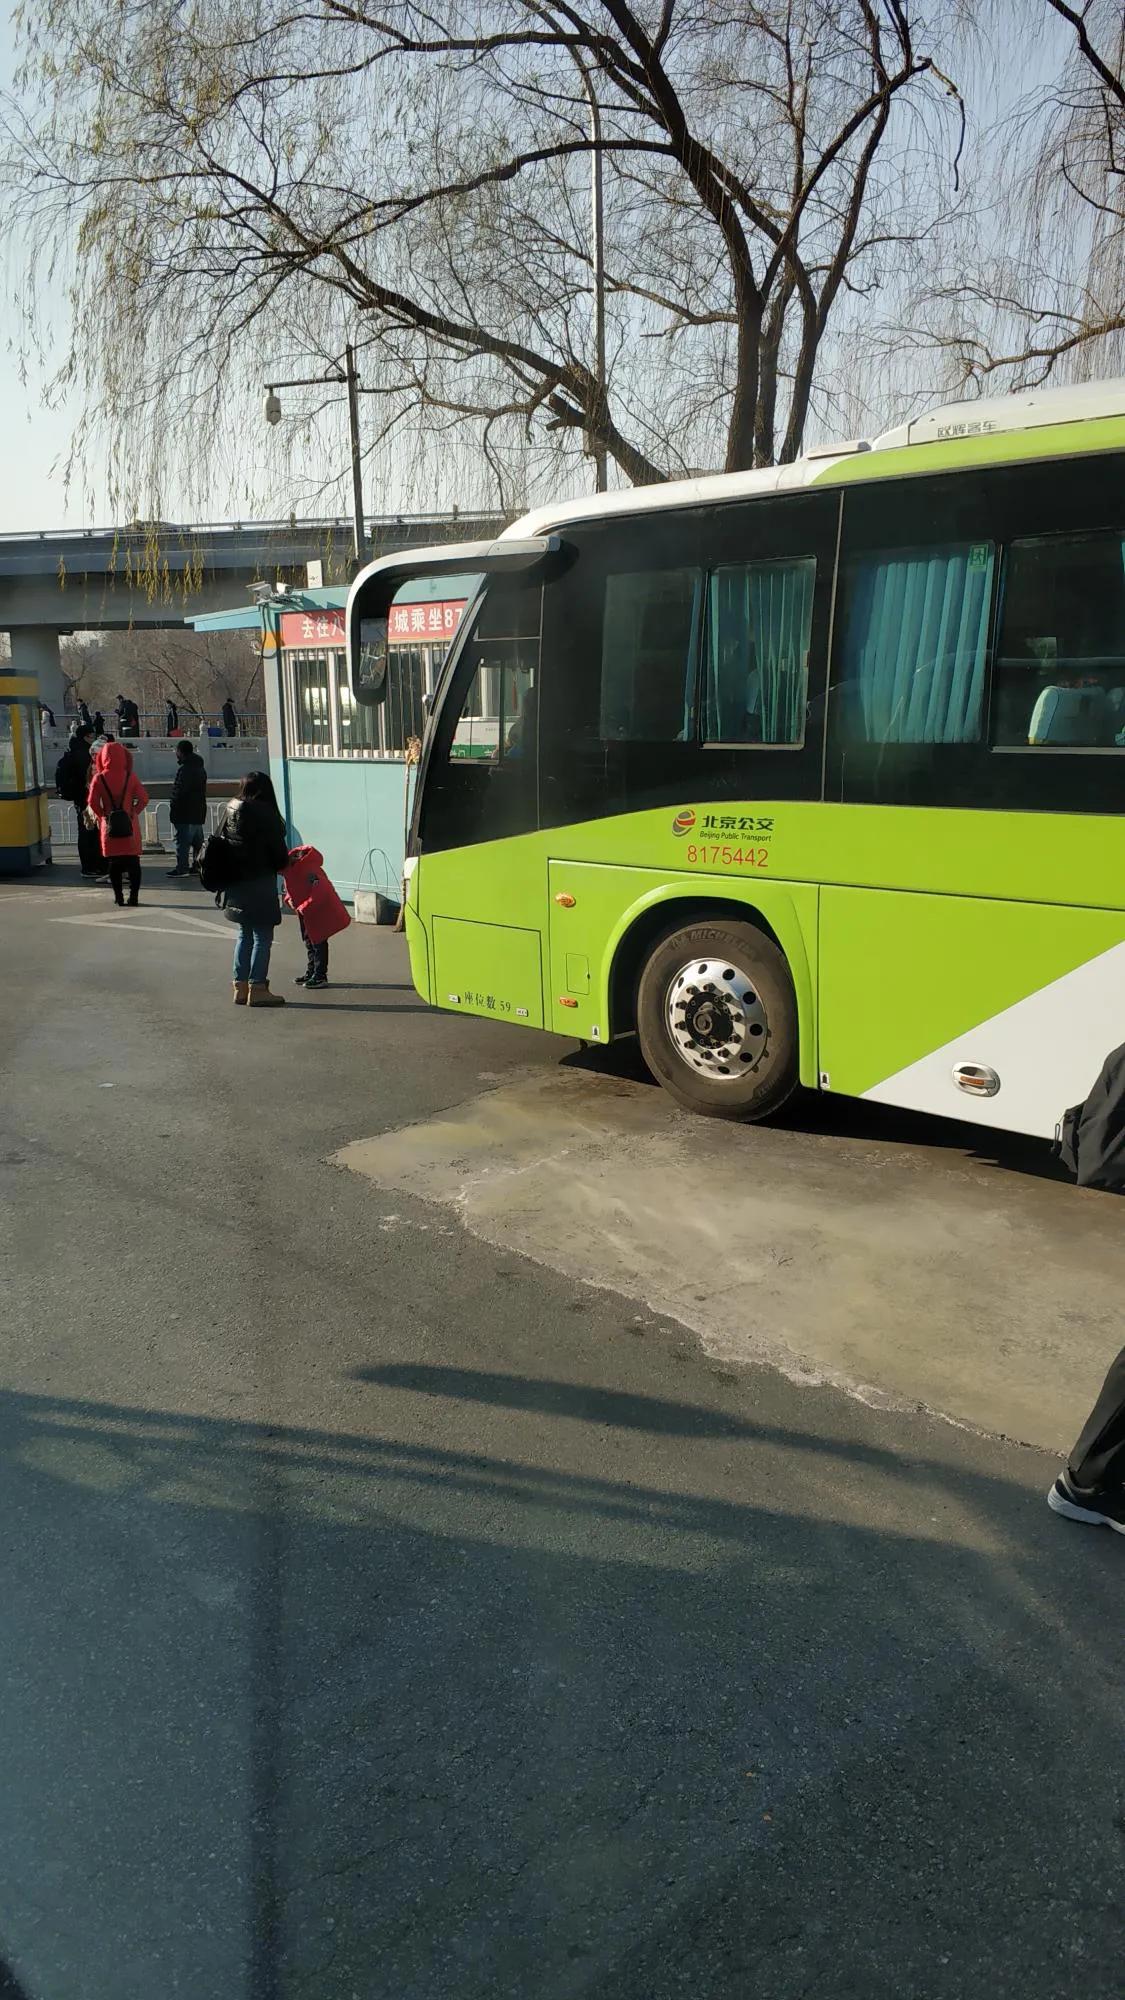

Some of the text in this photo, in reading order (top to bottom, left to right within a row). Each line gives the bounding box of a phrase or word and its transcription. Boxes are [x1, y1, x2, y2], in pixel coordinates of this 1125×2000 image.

[937, 420, 998, 438] 欧辉客车
[388, 607, 464, 633] 城乘坐87
[701, 815, 775, 831] 北京公交
[700, 831, 772, 842] Beijing Public Transport
[687, 845, 769, 867] 8175442
[500, 1000, 511, 1012] 59
